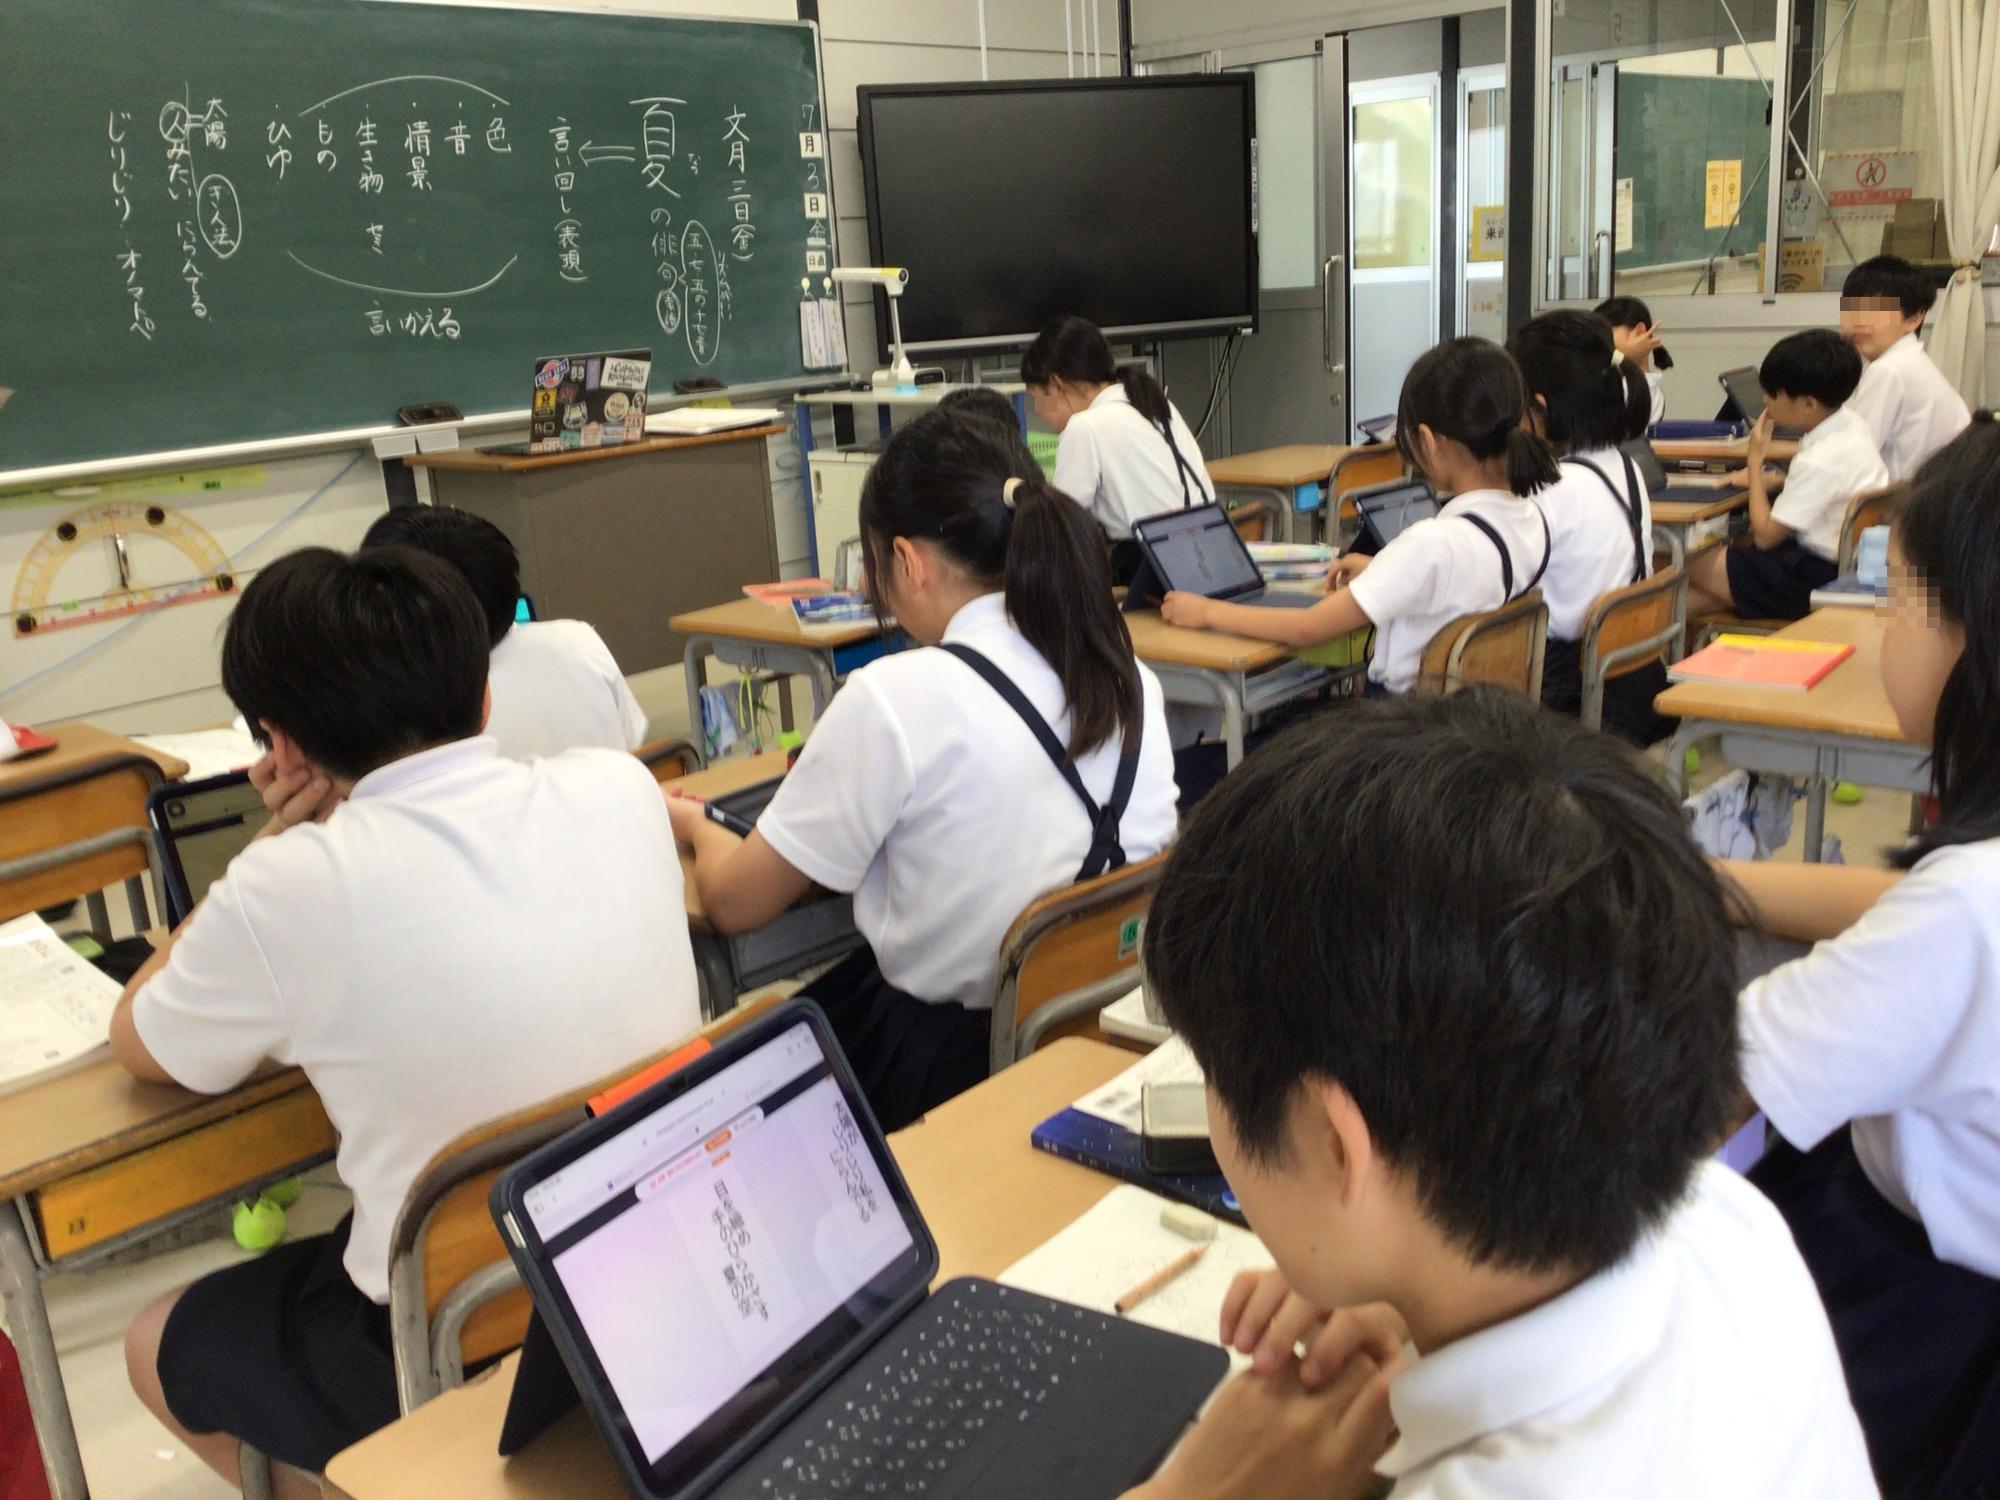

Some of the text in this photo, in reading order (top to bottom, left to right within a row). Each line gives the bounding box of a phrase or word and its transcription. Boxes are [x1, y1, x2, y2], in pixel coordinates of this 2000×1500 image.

[356, 117, 384, 193] 生き物
[116, 249, 156, 340] オノマトペ
[364, 300, 462, 339] 言いかえる
